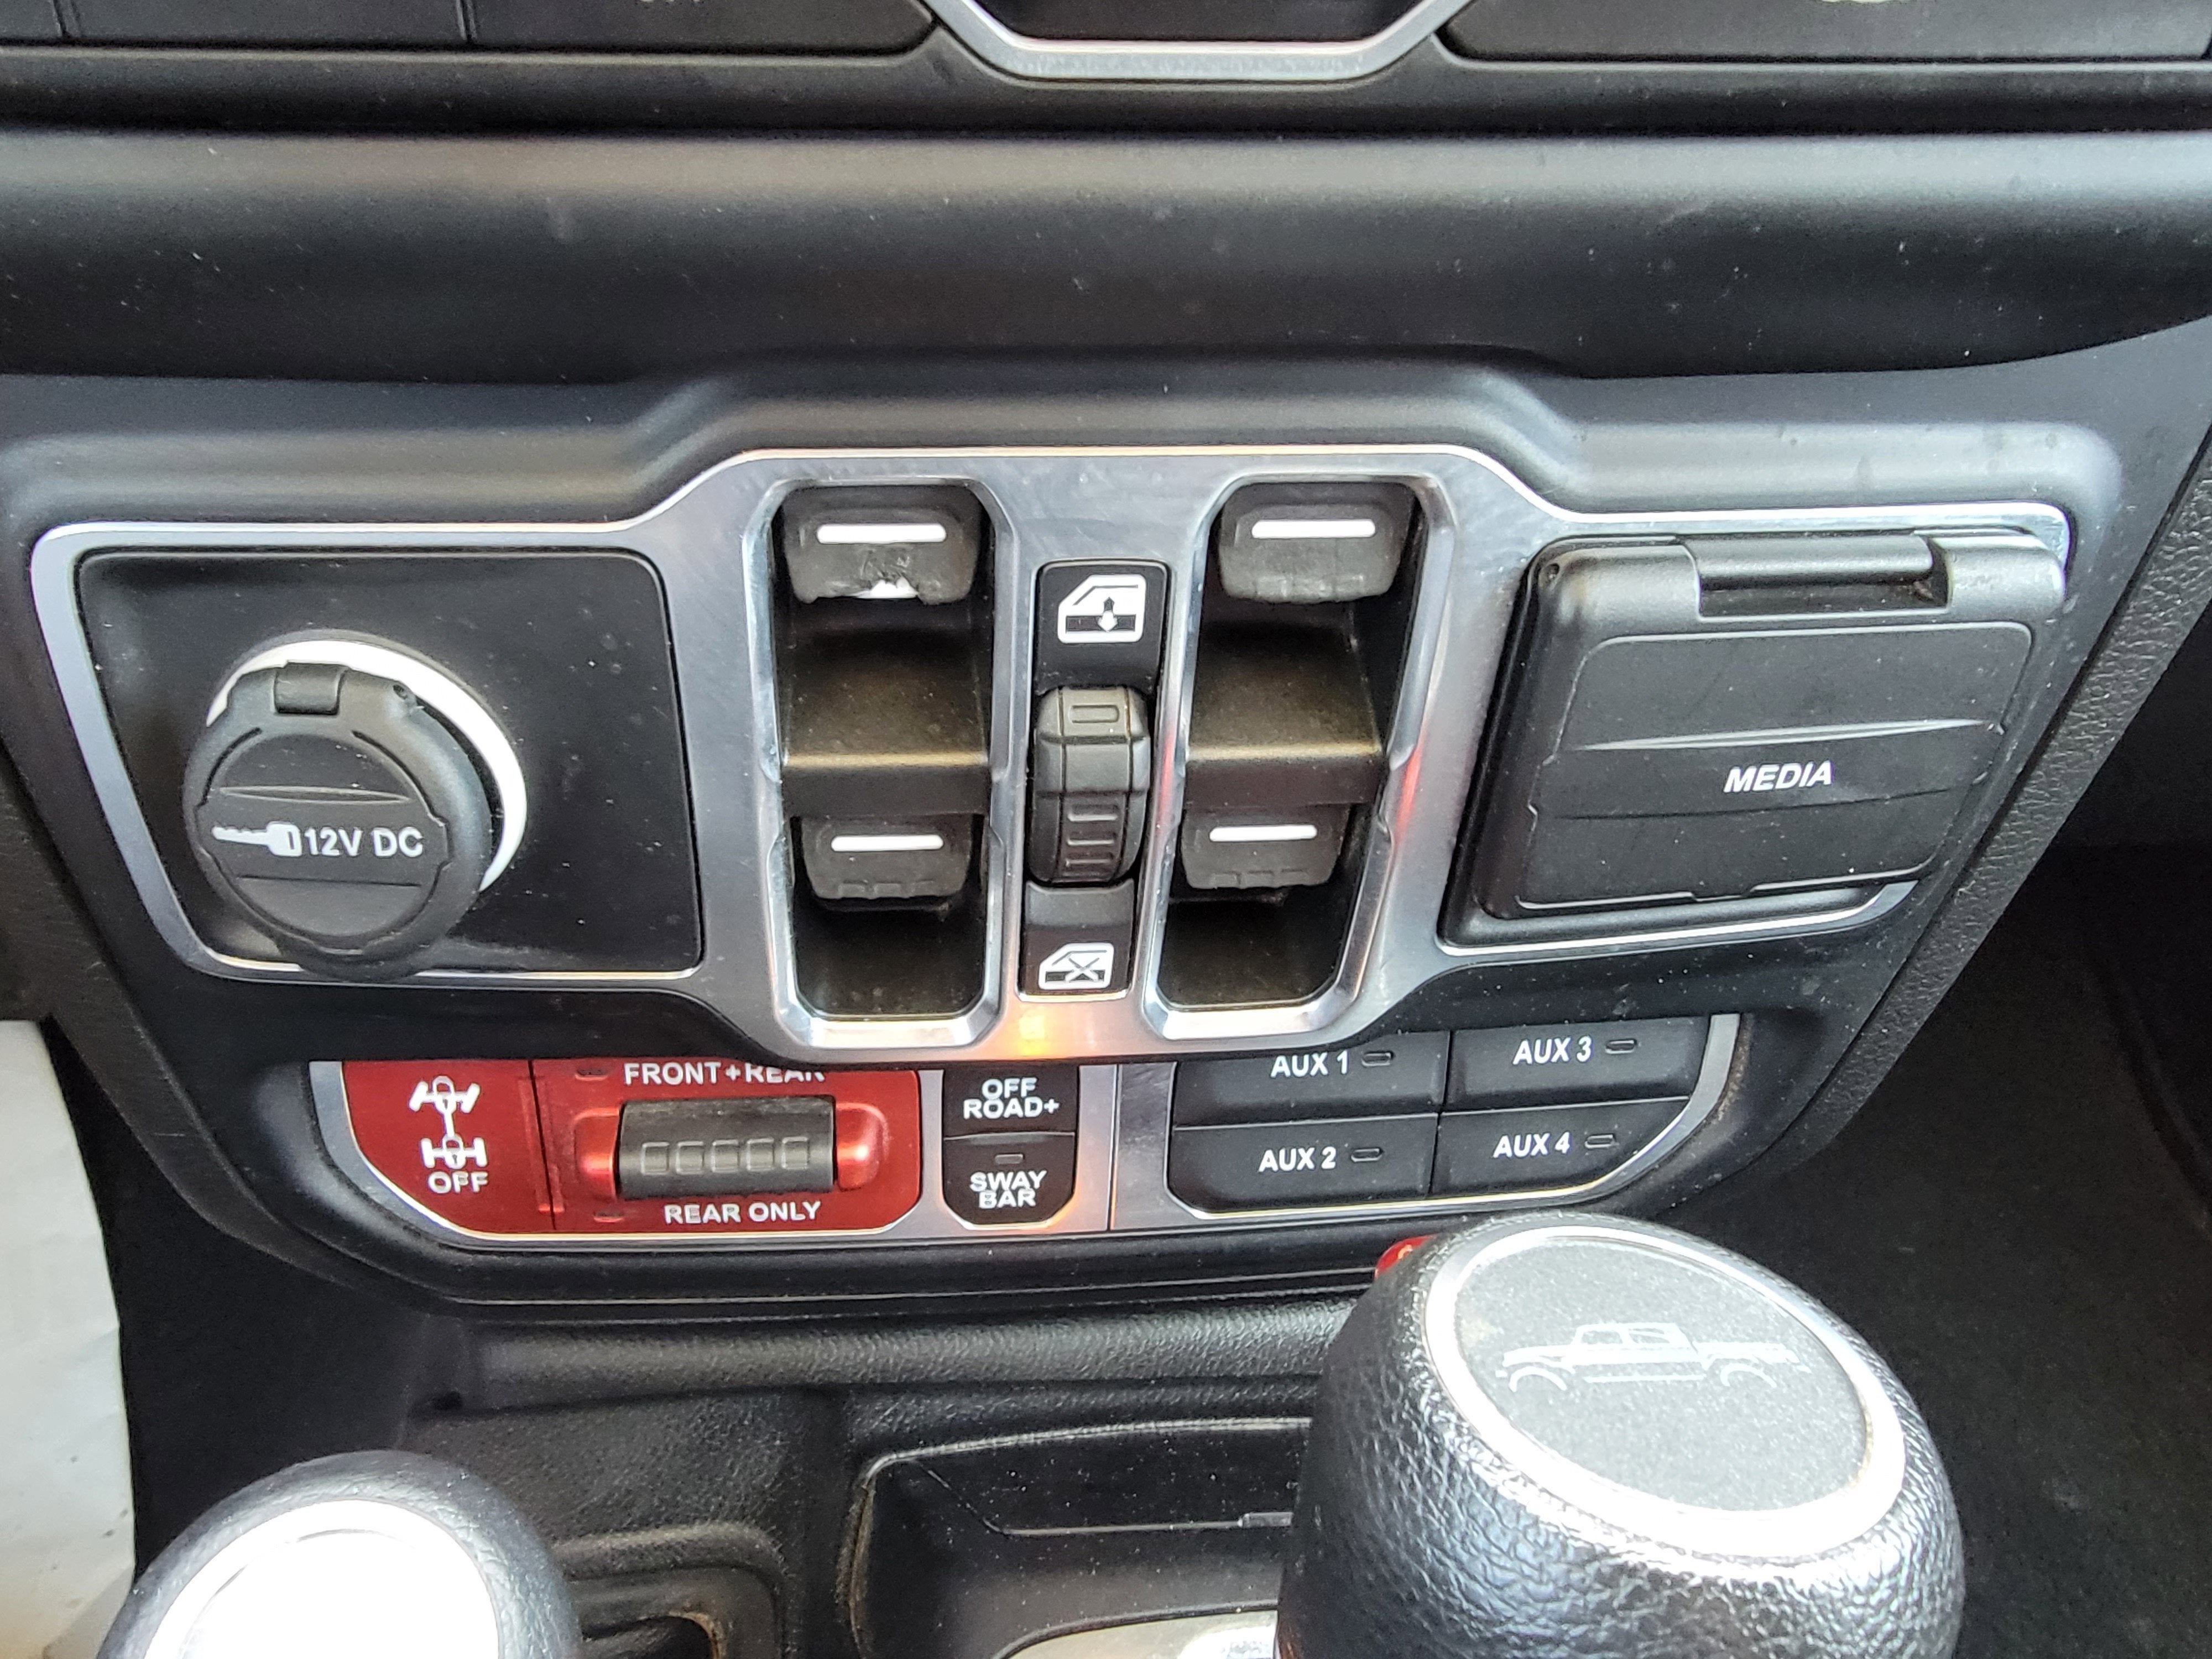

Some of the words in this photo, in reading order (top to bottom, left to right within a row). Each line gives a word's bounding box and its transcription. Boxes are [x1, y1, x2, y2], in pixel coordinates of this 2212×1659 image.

[1723, 760, 1833, 792] MEDIA
[305, 827, 362, 856] 12V
[371, 827, 424, 857] DC
[1512, 1037, 1571, 1065] AUX
[1576, 1035, 1593, 1063] 3
[1270, 1052, 1328, 1078] AUX
[1337, 1050, 1349, 1074] 1
[982, 1077, 1037, 1099] OFF
[963, 1097, 1060, 1119] ROAD+
[1493, 1133, 1550, 1158] AUX
[1554, 1131, 1571, 1155] 4
[1258, 1147, 1315, 1172] AUX
[1321, 1146, 1337, 1170] 2
[428, 1171, 488, 1193] OFF
[970, 1170, 1047, 1192] SWAY
[978, 1189, 1036, 1209] BAR
[664, 1203, 742, 1224] REAR
[748, 1201, 821, 1223] ONLY
